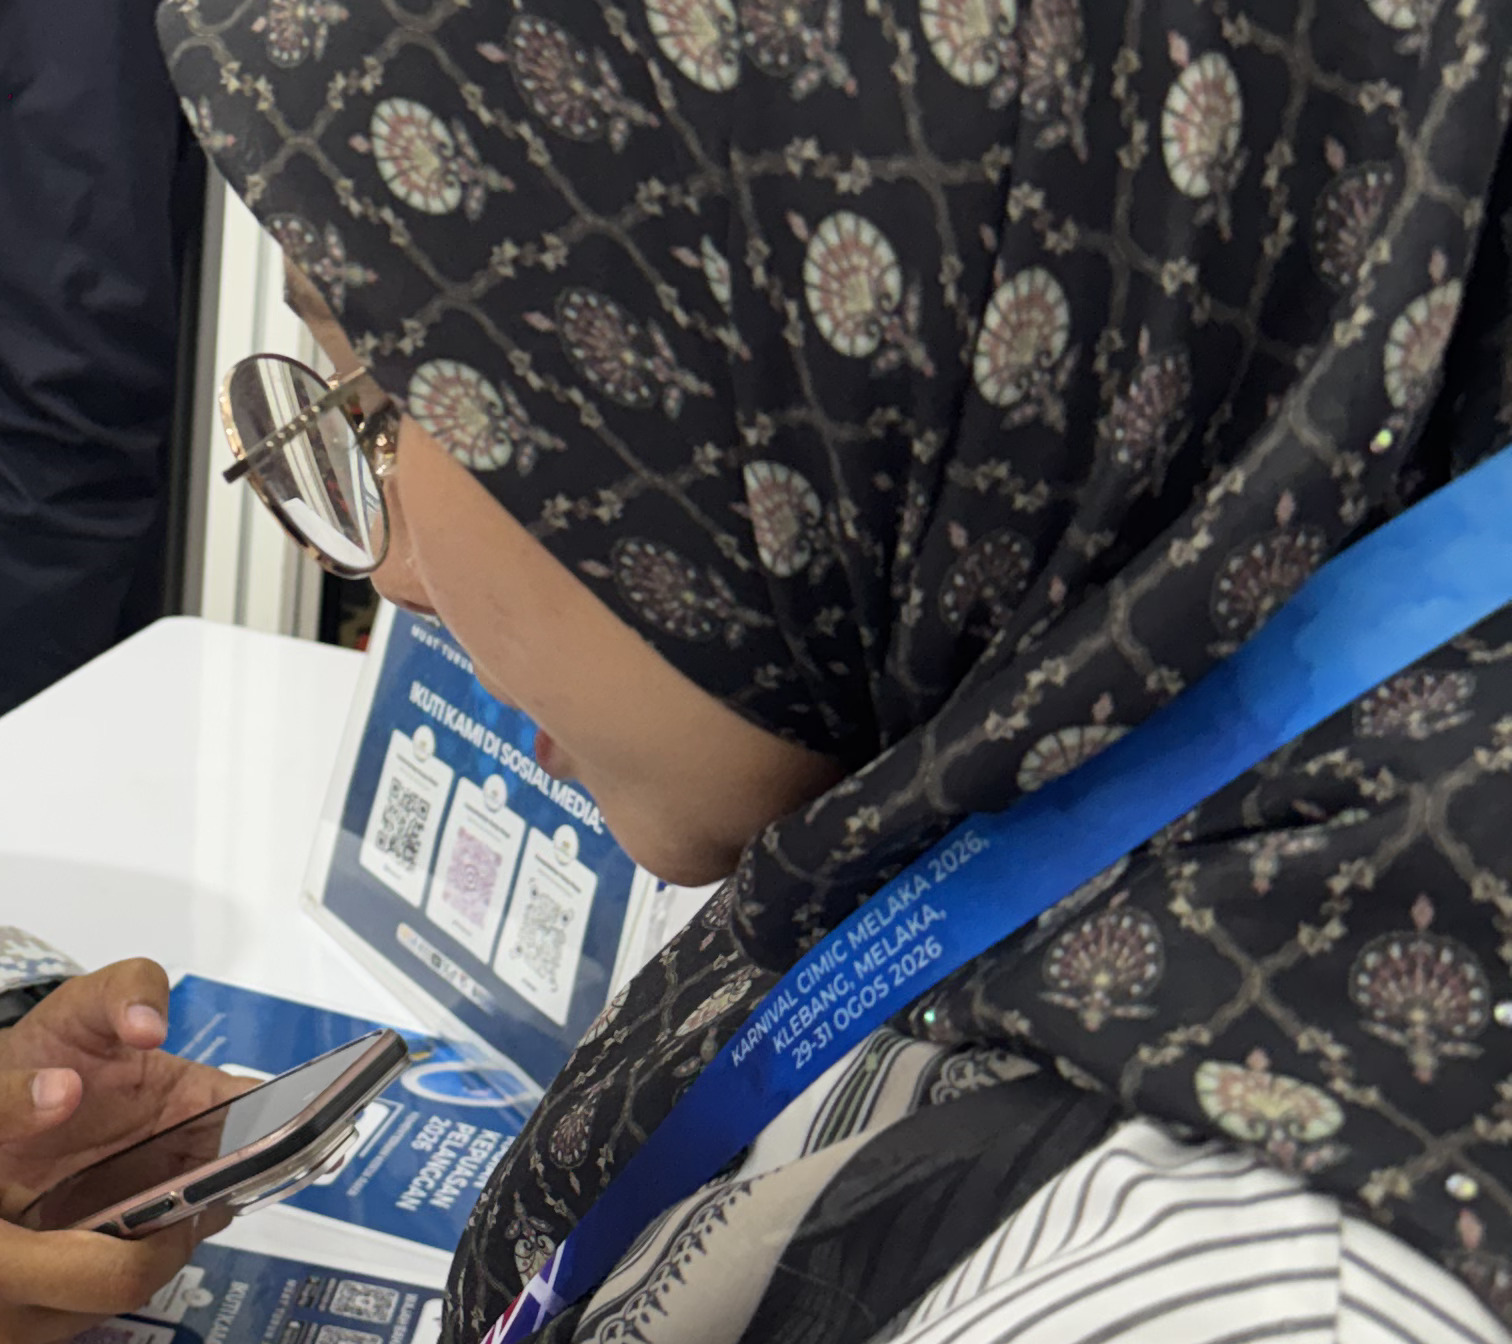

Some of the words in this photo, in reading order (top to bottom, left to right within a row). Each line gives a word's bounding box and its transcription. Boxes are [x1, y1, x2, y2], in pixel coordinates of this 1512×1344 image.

[409, 679, 448, 723] IKUTI
[445, 704, 485, 748] KAMI
[484, 730, 502, 760] DI
[501, 742, 551, 796] SOSIAL
[731, 992, 798, 1067] KARNIVAL
[796, 940, 849, 995] CIMIC
[847, 873, 931, 950] MELAKA
[928, 830, 990, 883] 2026,
[772, 973, 856, 1054] KLEBANG,
[854, 903, 947, 981] MELAKA,
[791, 1025, 833, 1070] 29-31
[833, 978, 889, 1031] OGOS
[888, 935, 943, 987] 2026
[427, 1126, 502, 1211] KEPUASAN
